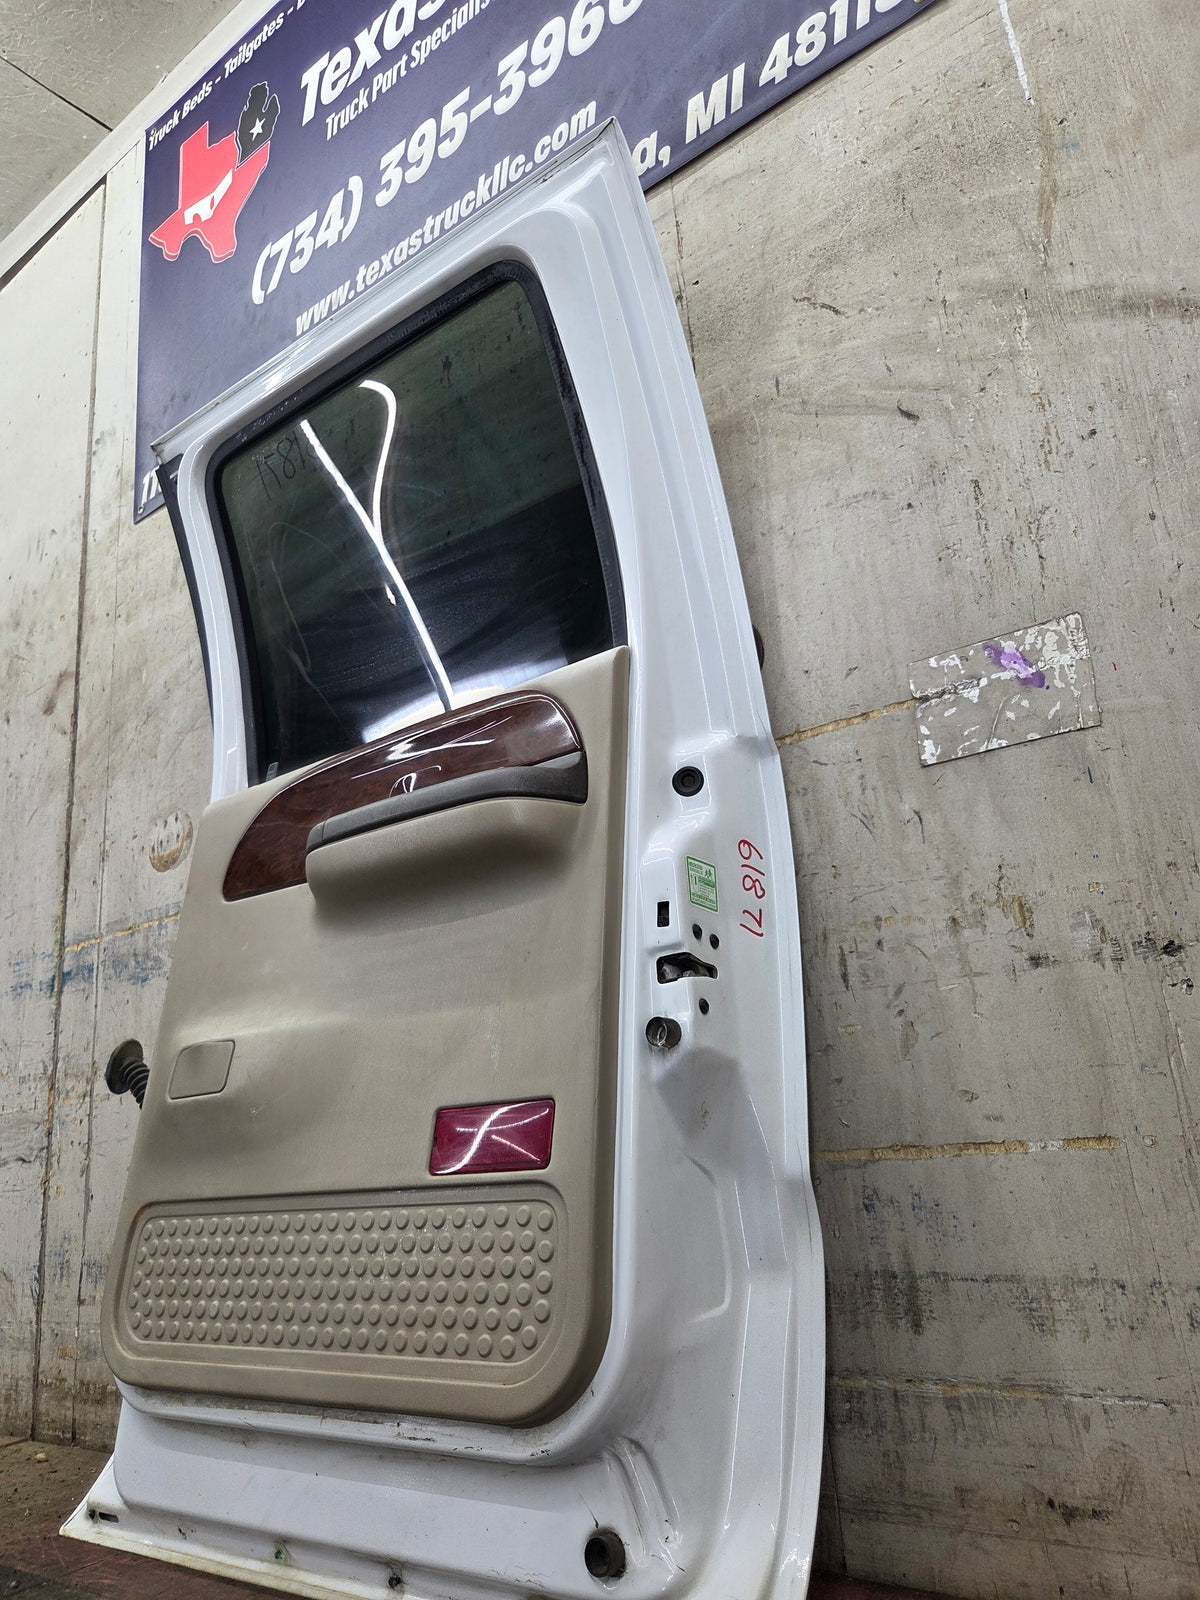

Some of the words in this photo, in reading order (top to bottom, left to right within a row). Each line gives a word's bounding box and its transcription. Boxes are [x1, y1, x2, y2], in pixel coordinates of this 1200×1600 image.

[149, 110, 181, 151] Truck
[182, 80, 213, 119] Beds
[224, 12, 285, 79] Tailgates
[326, 87, 369, 141] Truck
[372, 53, 409, 102] Part
[686, 62, 746, 145] MI
[759, 0, 902, 88] 4811
[251, 175, 364, 304] (734)
[295, 100, 597, 337] www.texastruckllc.com
